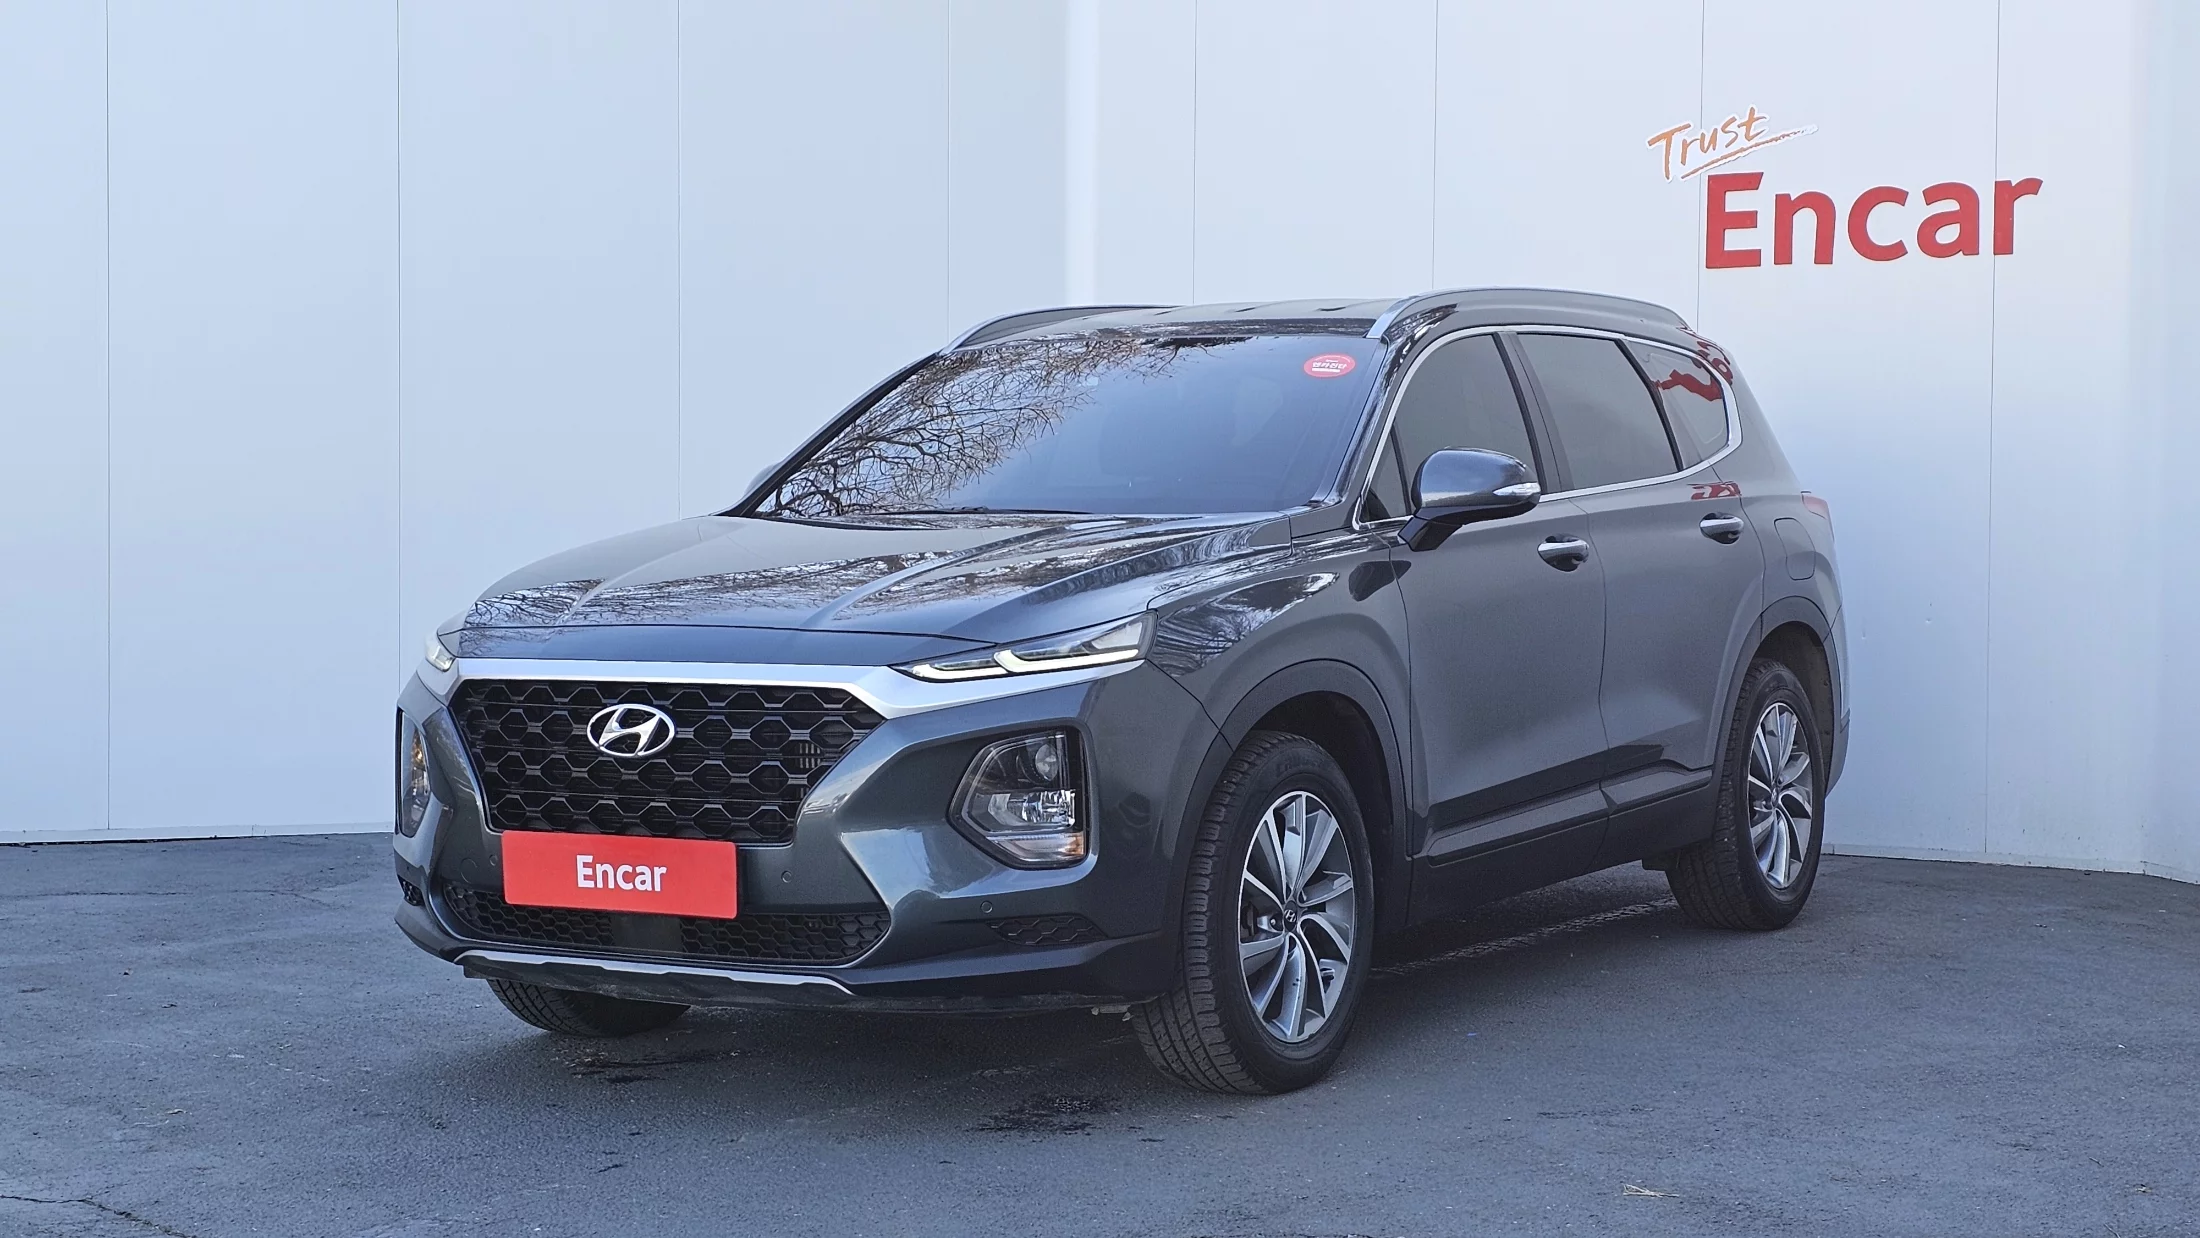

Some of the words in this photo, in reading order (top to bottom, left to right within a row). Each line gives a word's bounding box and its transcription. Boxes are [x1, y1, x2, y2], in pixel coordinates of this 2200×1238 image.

[1647, 106, 1768, 181] Trust
[1705, 172, 2044, 270] Encar
[576, 854, 668, 892] Encar
